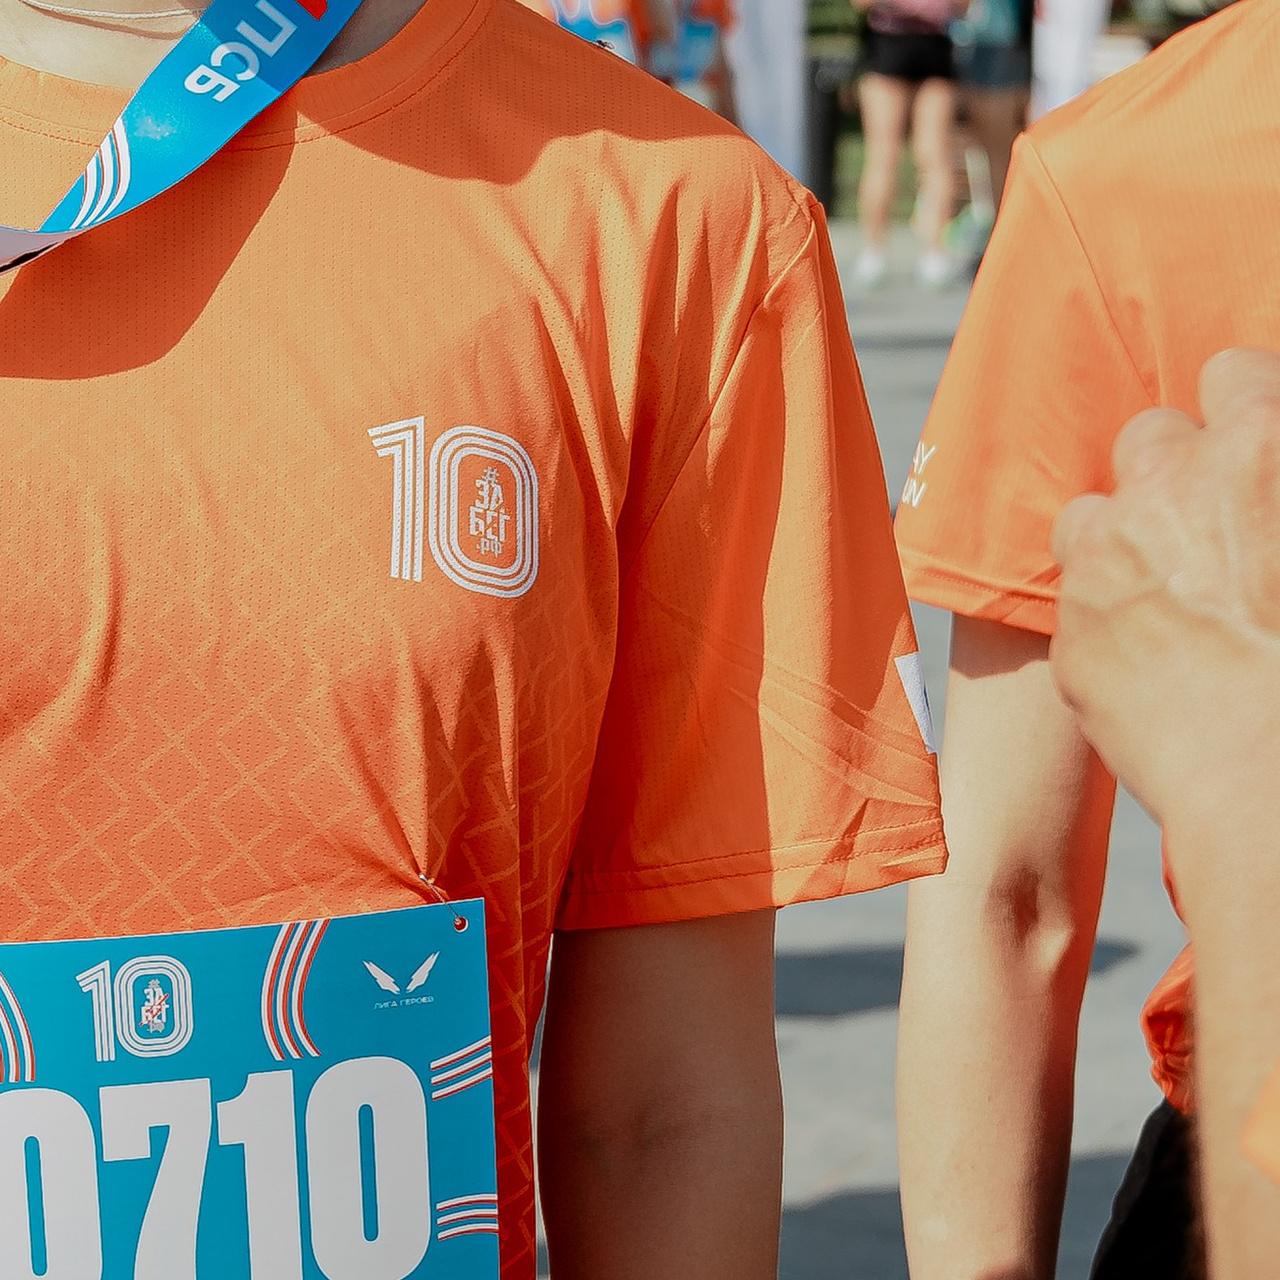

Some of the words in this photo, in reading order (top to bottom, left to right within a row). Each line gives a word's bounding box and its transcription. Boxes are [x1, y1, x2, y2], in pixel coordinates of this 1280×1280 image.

[367, 415, 540, 599] 10
[469, 505, 511, 542] БЕГ
[75, 954, 194, 1062] 10
